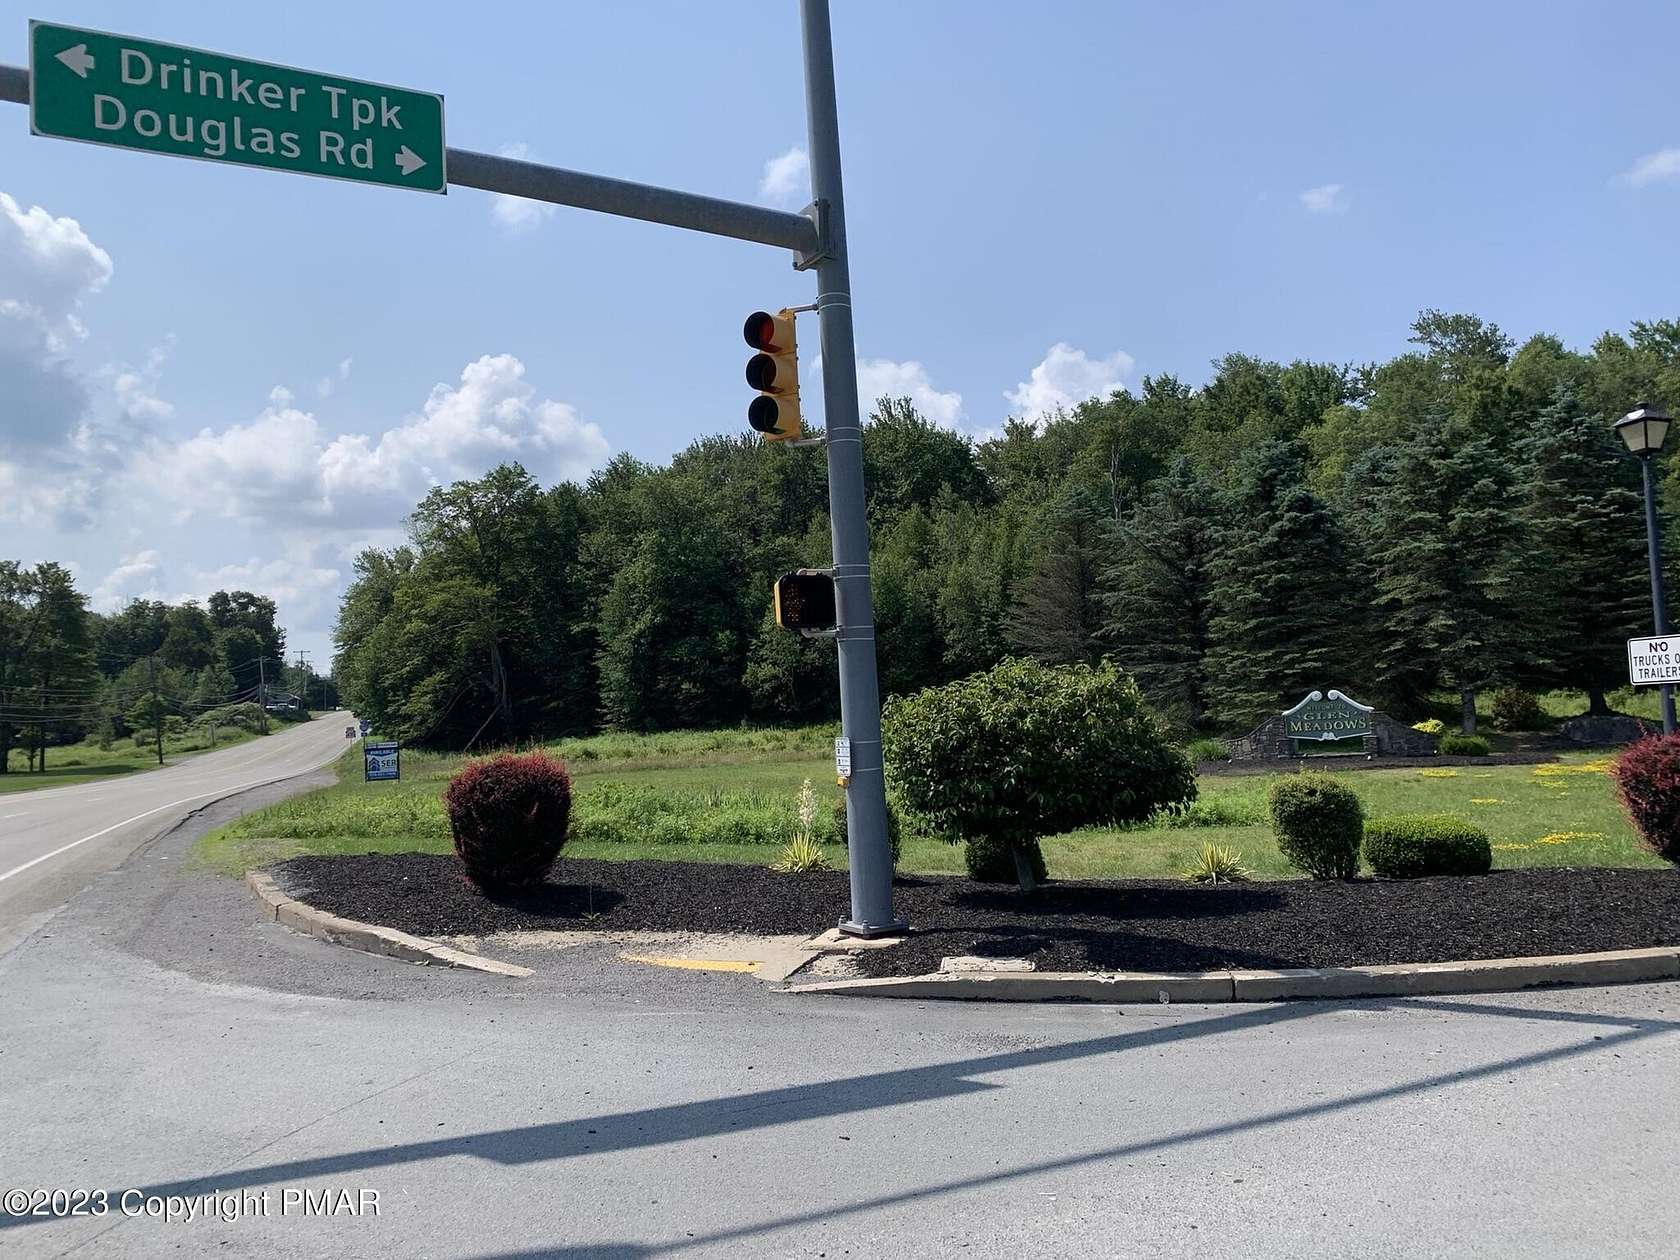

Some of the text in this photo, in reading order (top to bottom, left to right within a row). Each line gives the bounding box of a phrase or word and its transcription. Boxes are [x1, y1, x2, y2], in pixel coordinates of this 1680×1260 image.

[120, 48, 403, 130] Drinker Tpk
[93, 94, 374, 169] Douglas Rd
[1649, 641, 1668, 652] NO
[1633, 654, 1670, 666] TRUCKS
[1304, 712, 1350, 720] GLEN
[1290, 717, 1366, 731] MEADOWS
